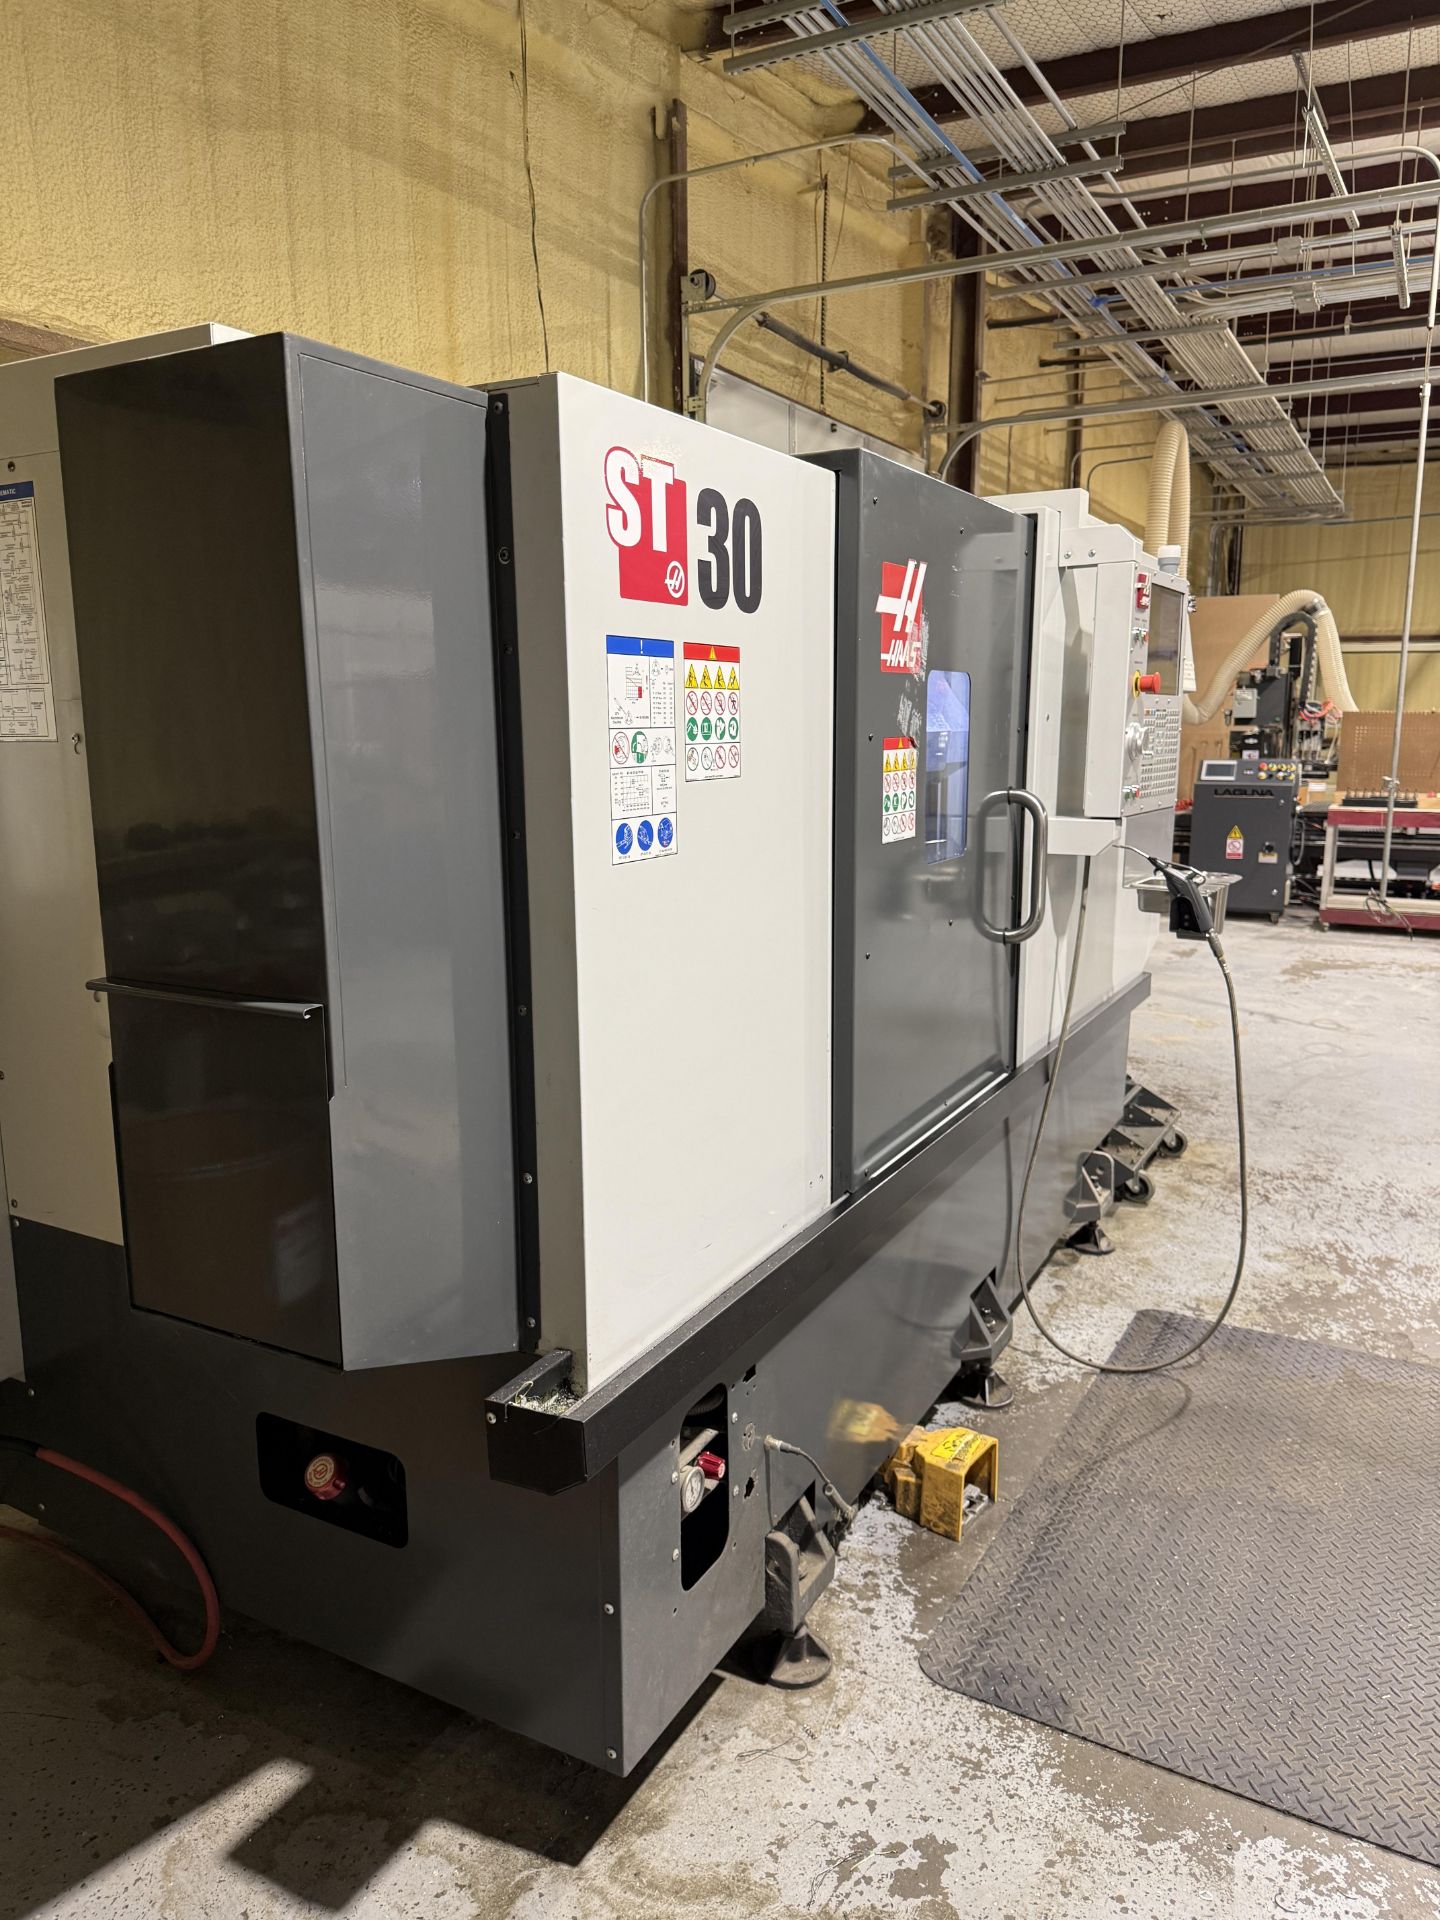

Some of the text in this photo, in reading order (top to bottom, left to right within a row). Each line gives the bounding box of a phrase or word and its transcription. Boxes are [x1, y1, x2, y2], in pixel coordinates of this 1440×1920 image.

[605, 446, 763, 614] ST 30
[880, 639, 922, 668] HAAS
[1214, 788, 1274, 796] LAGUNA
